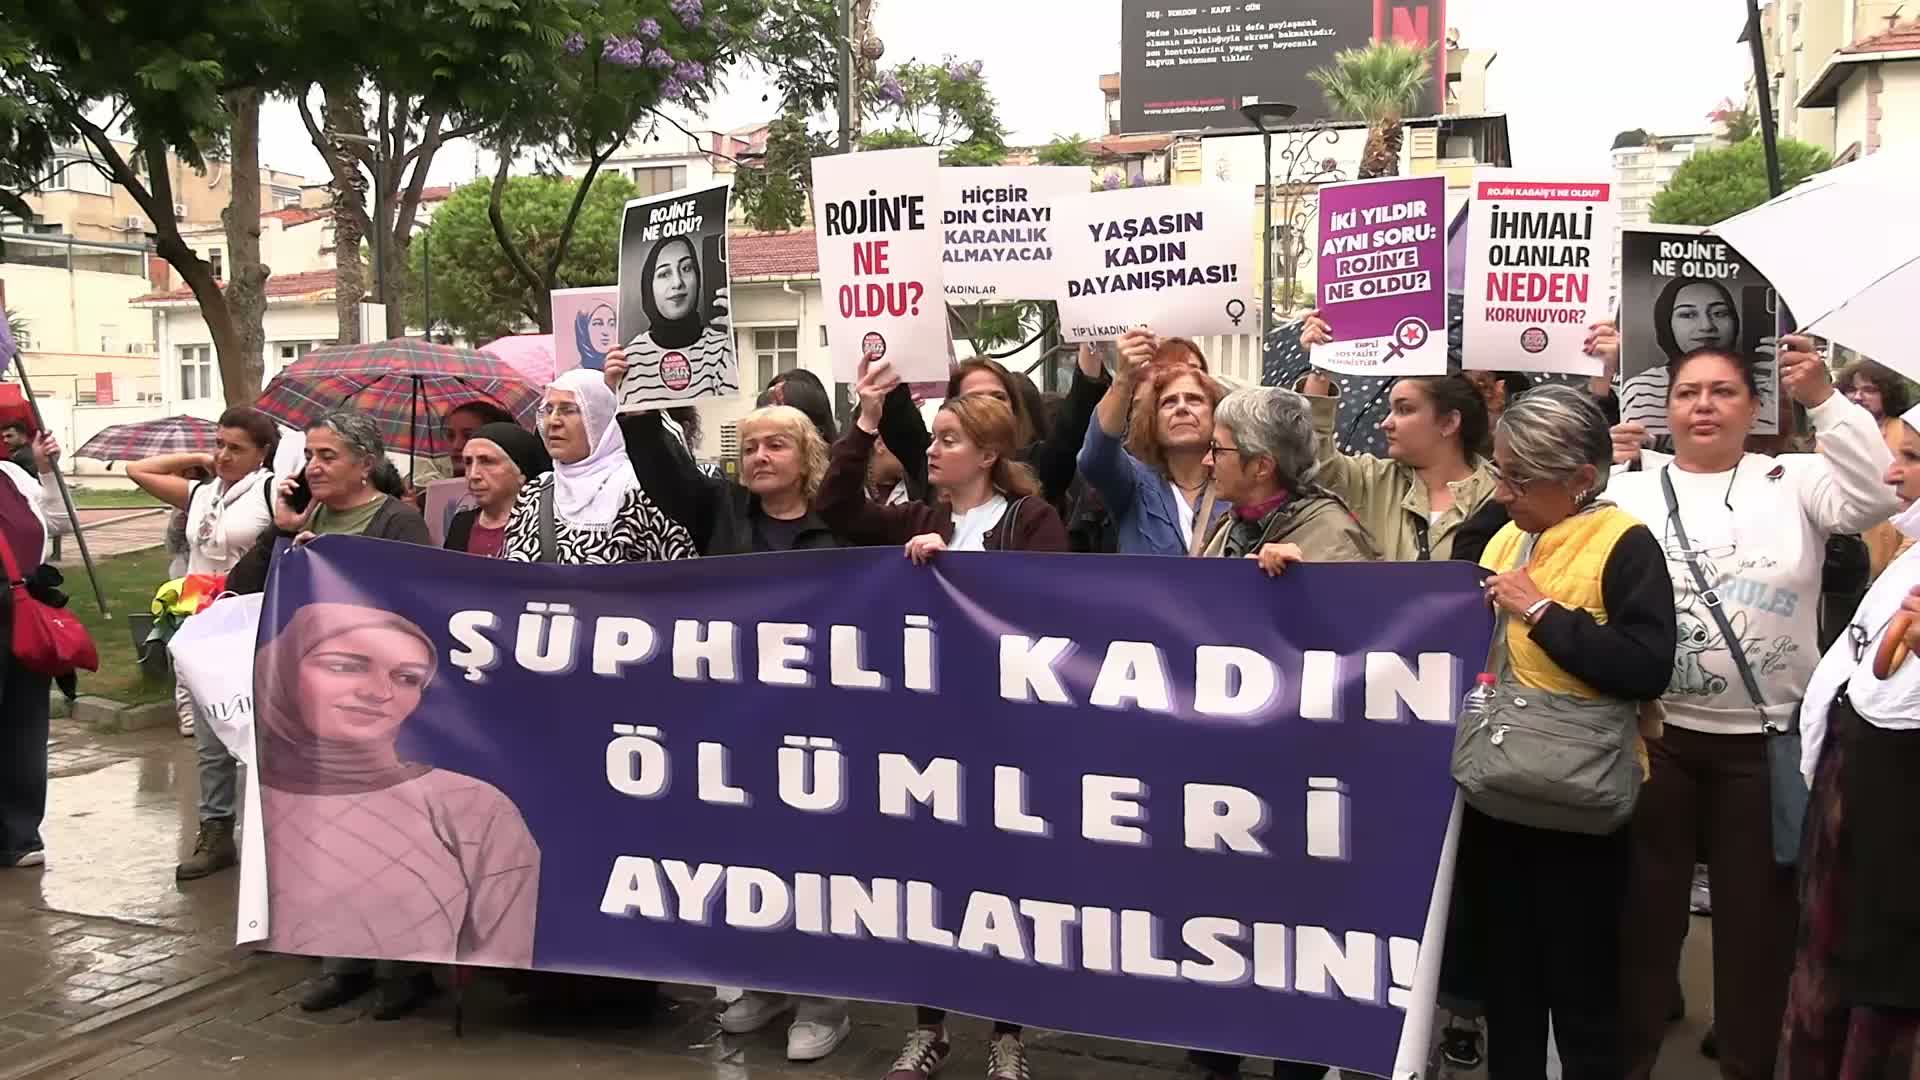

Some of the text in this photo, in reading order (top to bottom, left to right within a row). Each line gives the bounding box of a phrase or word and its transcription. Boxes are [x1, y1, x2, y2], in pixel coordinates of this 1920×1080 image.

[1226, 23, 1241, 33] ilk
[1245, 23, 1265, 32] defa
[1269, 19, 1317, 31] paylaşacak
[1245, 31, 1274, 41] ekrana
[1165, 45, 1224, 56] kontrollerini
[1229, 44, 1254, 54] yapar
[1273, 38, 1317, 50] heyecanla
[961, 184, 1028, 206] HİÇBİR
[1487, 187, 1514, 196] ROJİN
[1557, 189, 1568, 197] NE
[1570, 189, 1600, 198] OLDU?
[650, 200, 697, 225] ROJİN'E
[825, 189, 925, 236] ROJİN'E
[941, 209, 977, 225] DIN
[1330, 200, 1427, 232] İKİ YILDIR
[1490, 204, 1593, 241] İHMALİ
[642, 216, 703, 242] NE OLDU?
[944, 227, 1047, 245] KARANLIK
[1088, 211, 1204, 242] YAŞASIN
[1321, 223, 1436, 257] AYNI SORU:
[1660, 240, 1726, 261] ROJİN'E
[853, 240, 890, 276] NE
[942, 247, 1053, 262] ALMAYACA
[1105, 241, 1186, 268] KADIN
[1339, 250, 1415, 276] ROJİN'E
[1488, 245, 1590, 267] OLANLAR
[1067, 264, 1238, 298] DAYANIŞMASI!
[1652, 260, 1740, 279] NE OLDU?
[839, 281, 924, 319] OLDU?
[1328, 273, 1427, 301] NE OLDU?
[1486, 272, 1588, 303] NEDEN
[1485, 307, 1586, 324] KORUNUYOR?
[448, 601, 1461, 725] ŞÜPHELİ KADIN
[605, 724, 1352, 861] ÖLÜMLERİ
[600, 855, 1420, 1008] AYDINLATILSIN!
